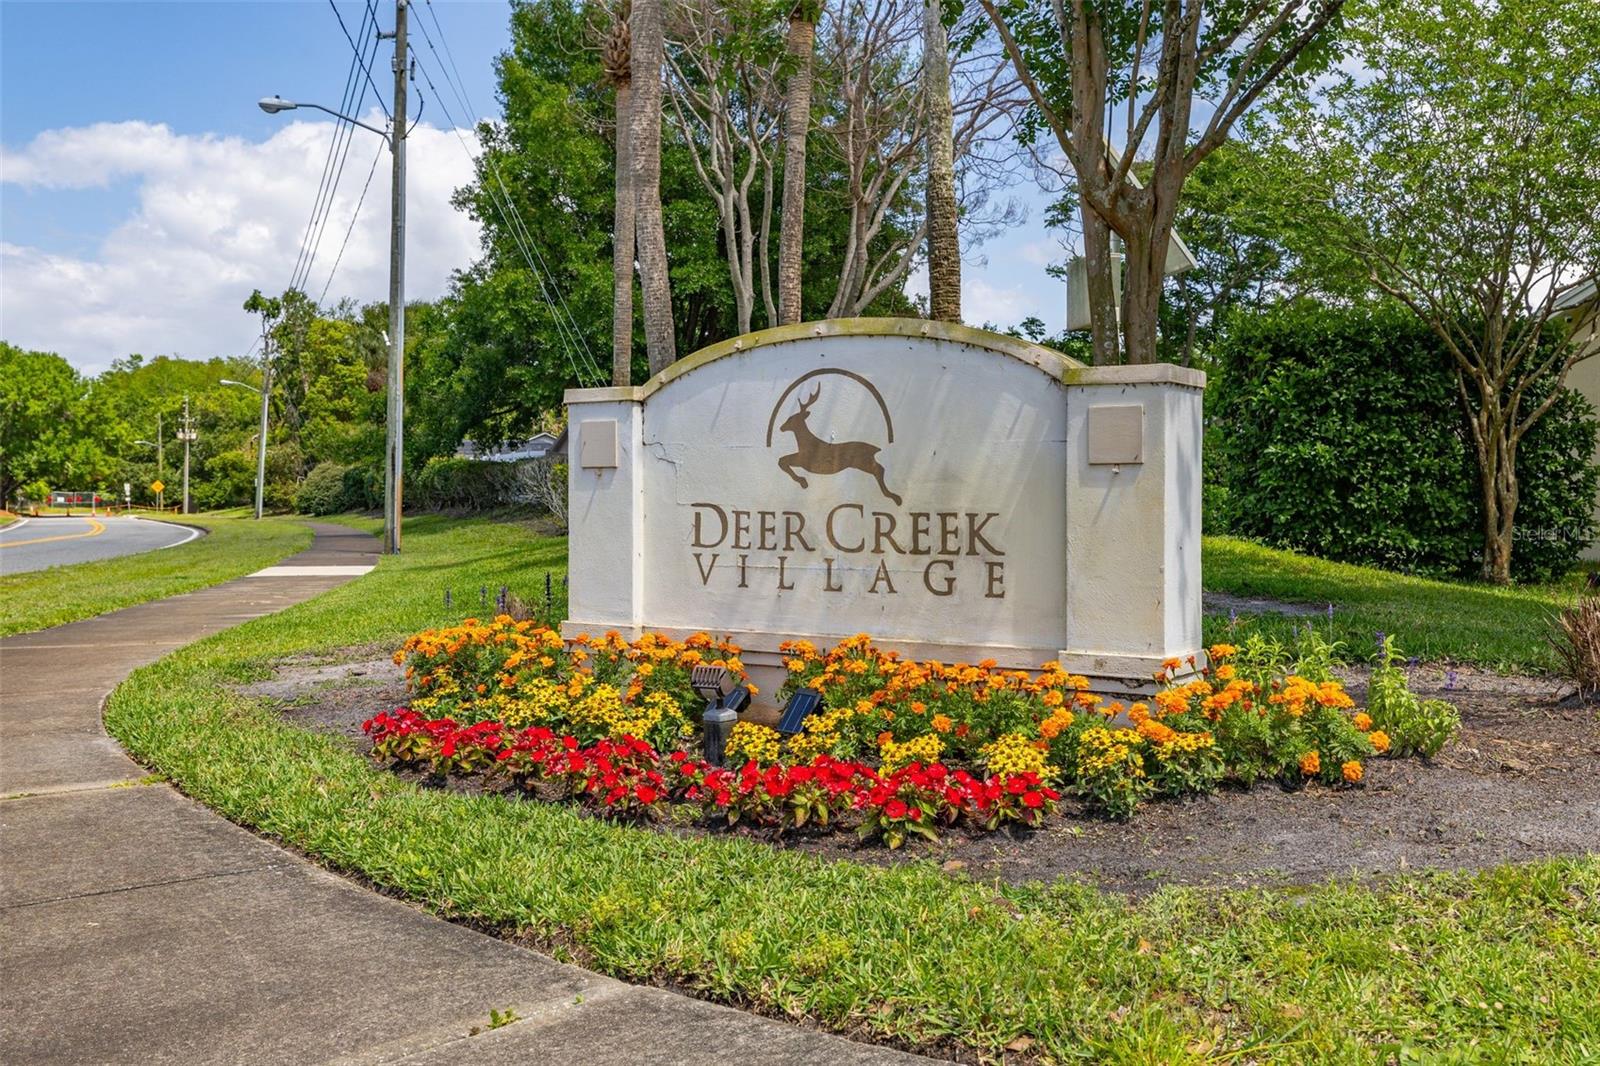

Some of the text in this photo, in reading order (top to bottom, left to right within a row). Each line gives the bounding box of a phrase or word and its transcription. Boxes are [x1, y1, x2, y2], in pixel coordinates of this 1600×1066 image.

[691, 502, 1005, 556] DEER CREEK
[693, 553, 1005, 598] VILLAGE
